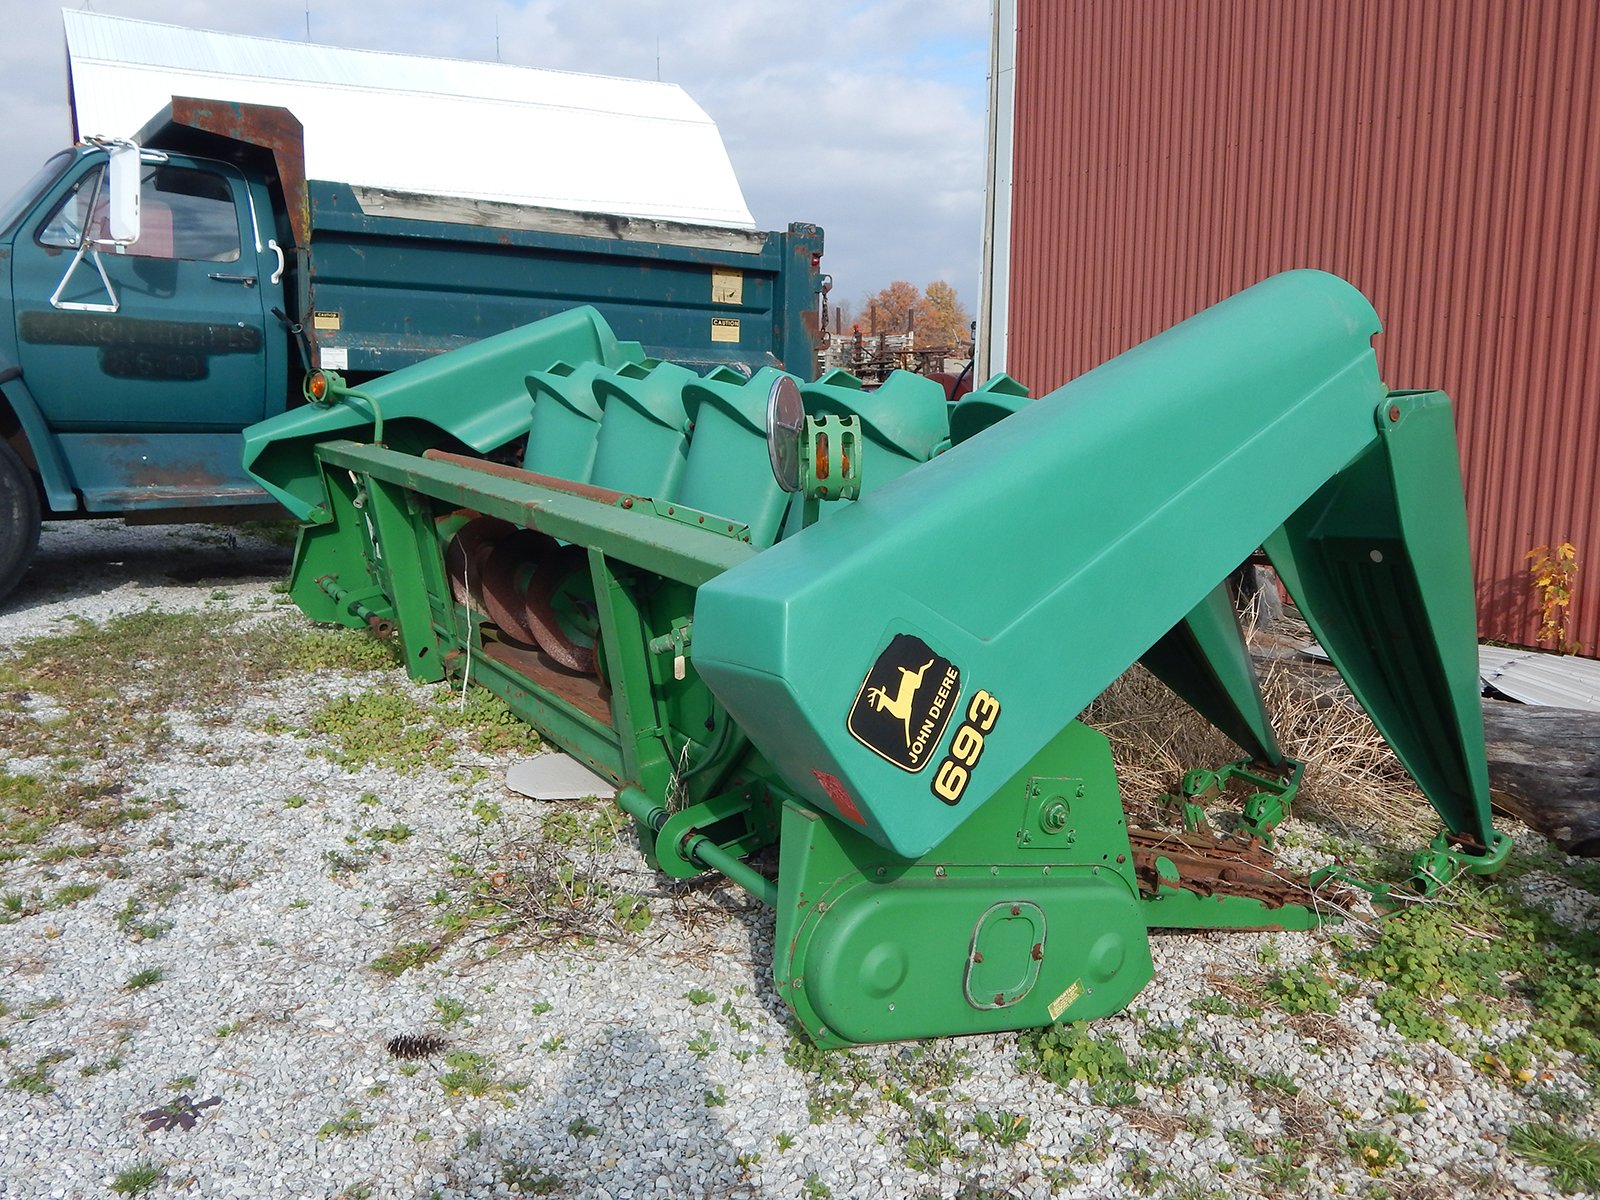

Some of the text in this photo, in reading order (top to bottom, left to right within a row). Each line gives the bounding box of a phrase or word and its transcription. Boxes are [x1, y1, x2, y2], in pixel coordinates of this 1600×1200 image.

[713, 319, 739, 327] CAUTION
[907, 666, 958, 764] JOHN DEERE
[932, 689, 1001, 805] 693
